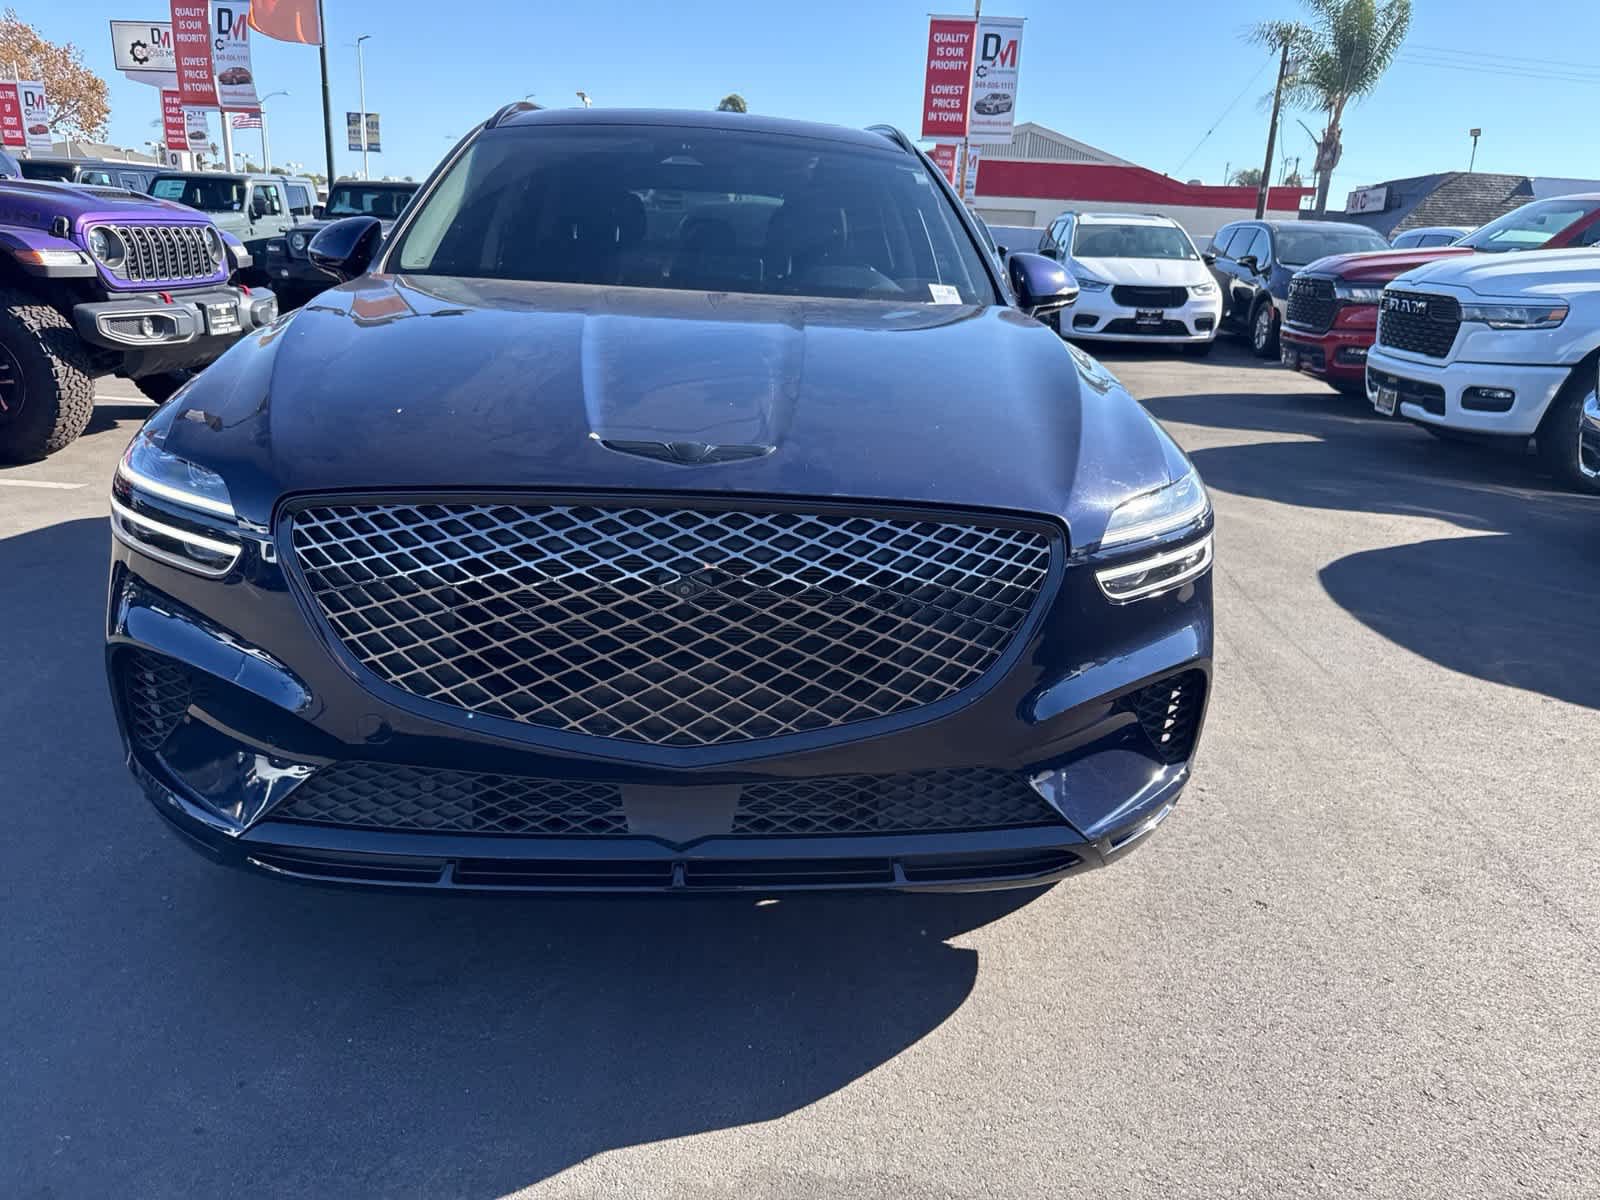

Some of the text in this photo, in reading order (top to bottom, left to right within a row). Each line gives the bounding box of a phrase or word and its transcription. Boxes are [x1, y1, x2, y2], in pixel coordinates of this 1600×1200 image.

[175, 7, 205, 17] QUALITY
[179, 21, 202, 30] IS OUR
[176, 33, 207, 43] PRIORITY
[933, 32, 969, 43] QUALITY
[936, 47, 964, 57] IS OUR
[181, 57, 208, 66] LOWEST
[930, 60, 968, 71] PRIORITY
[184, 70, 209, 80] PRICES
[183, 82, 214, 92] IN TOWN
[931, 84, 965, 95] LOWEST
[932, 98, 960, 109] PRICES
[927, 112, 963, 122] IN TOWN
[1389, 297, 1427, 313] RAM
